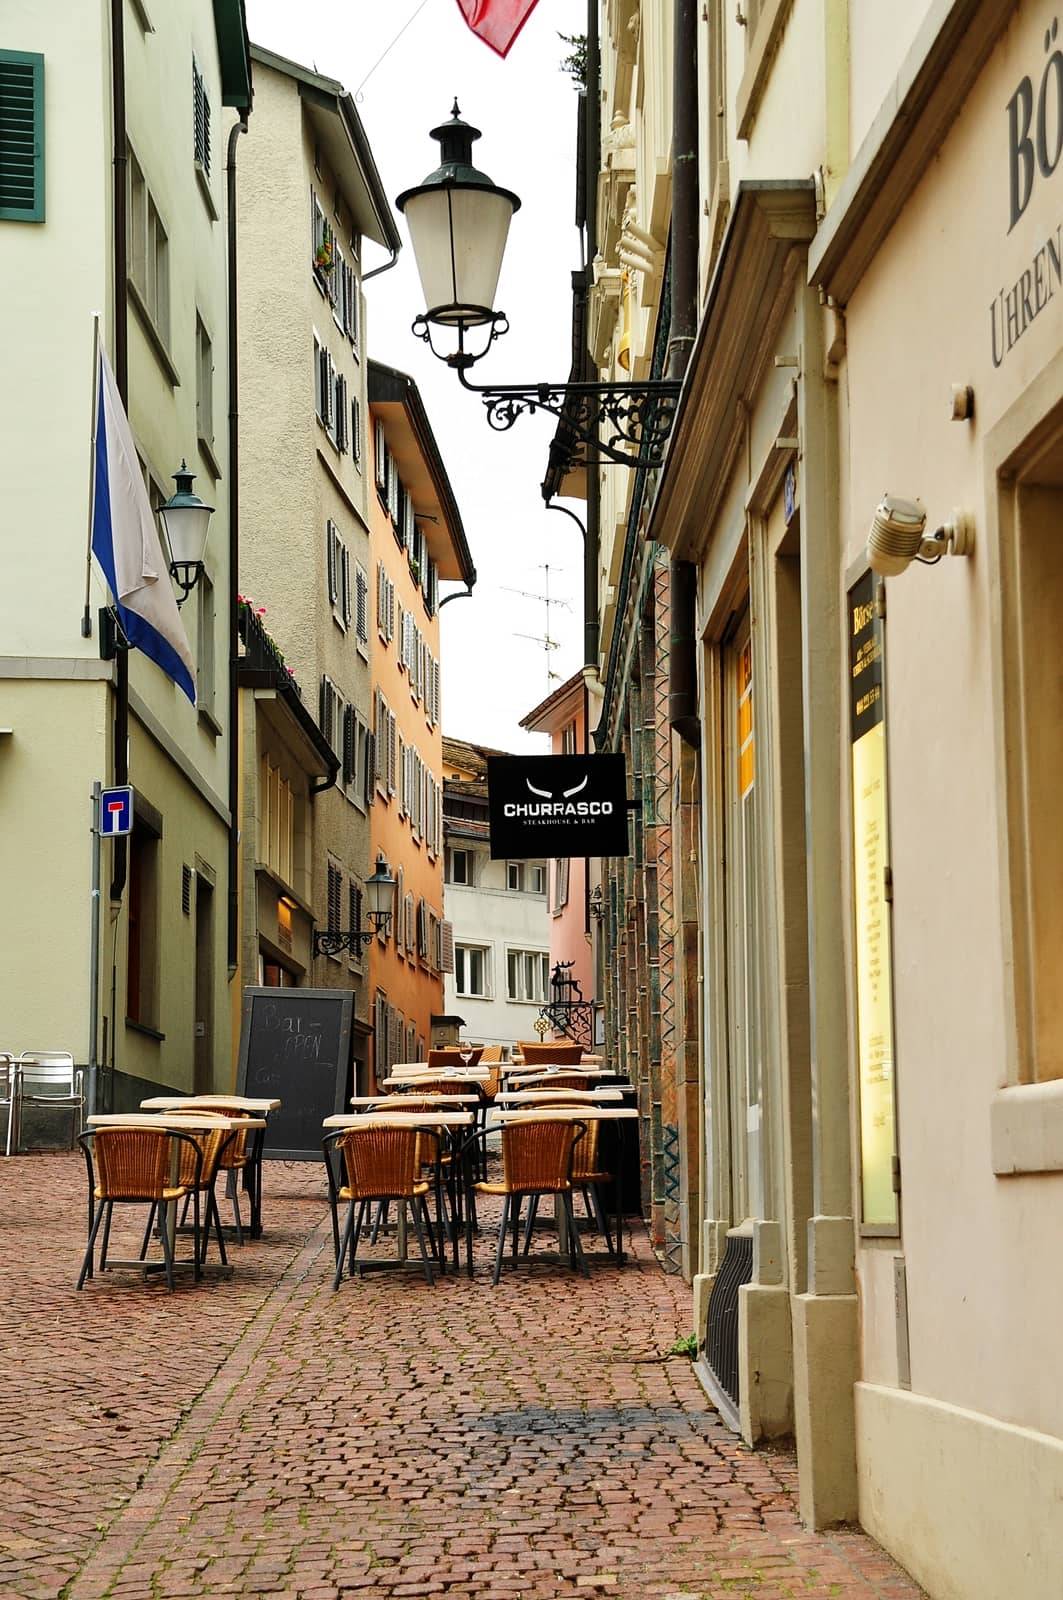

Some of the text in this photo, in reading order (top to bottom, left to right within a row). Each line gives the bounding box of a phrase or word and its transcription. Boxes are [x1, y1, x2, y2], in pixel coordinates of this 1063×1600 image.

[989, 224, 1063, 369] UHREN
[504, 802, 613, 816] CHURRASCO
[285, 1033, 323, 1060] OPEN
